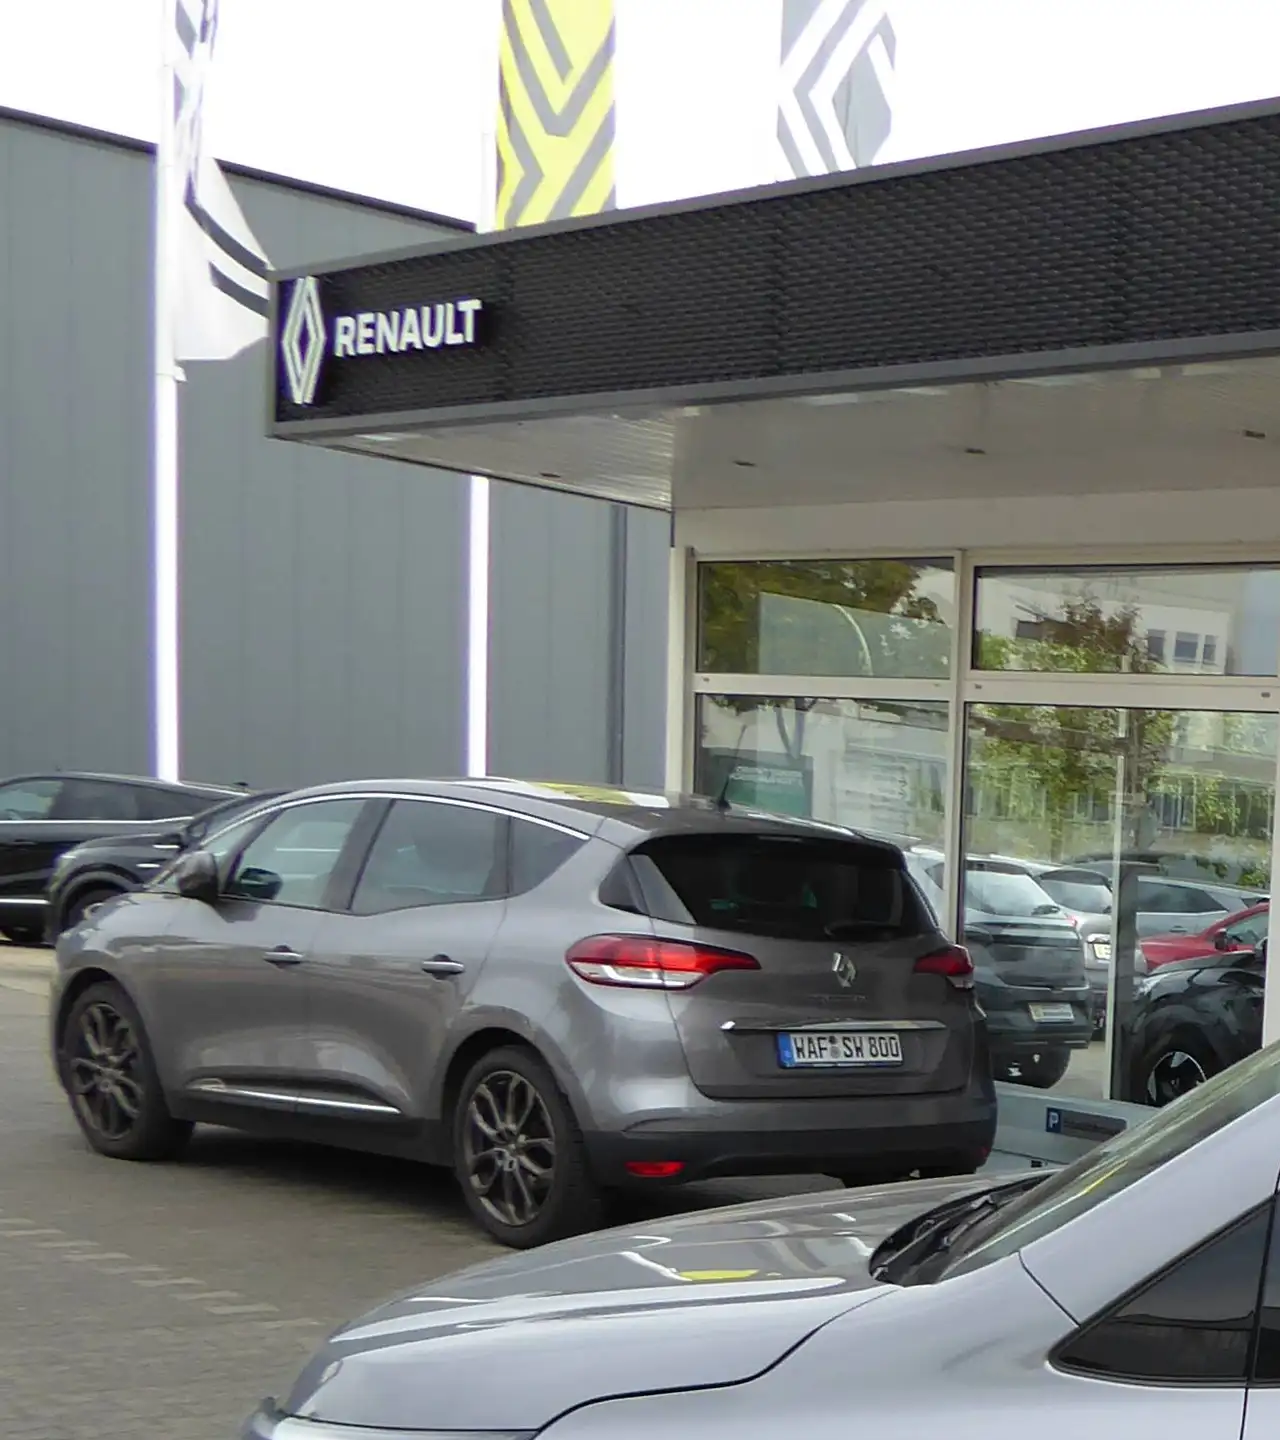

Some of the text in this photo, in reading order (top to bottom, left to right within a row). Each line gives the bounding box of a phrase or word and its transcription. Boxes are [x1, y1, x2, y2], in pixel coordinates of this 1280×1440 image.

[334, 298, 483, 358] RENAULT
[793, 1035, 900, 1060] WAF SW 800
[1049, 1111, 1060, 1129] P
